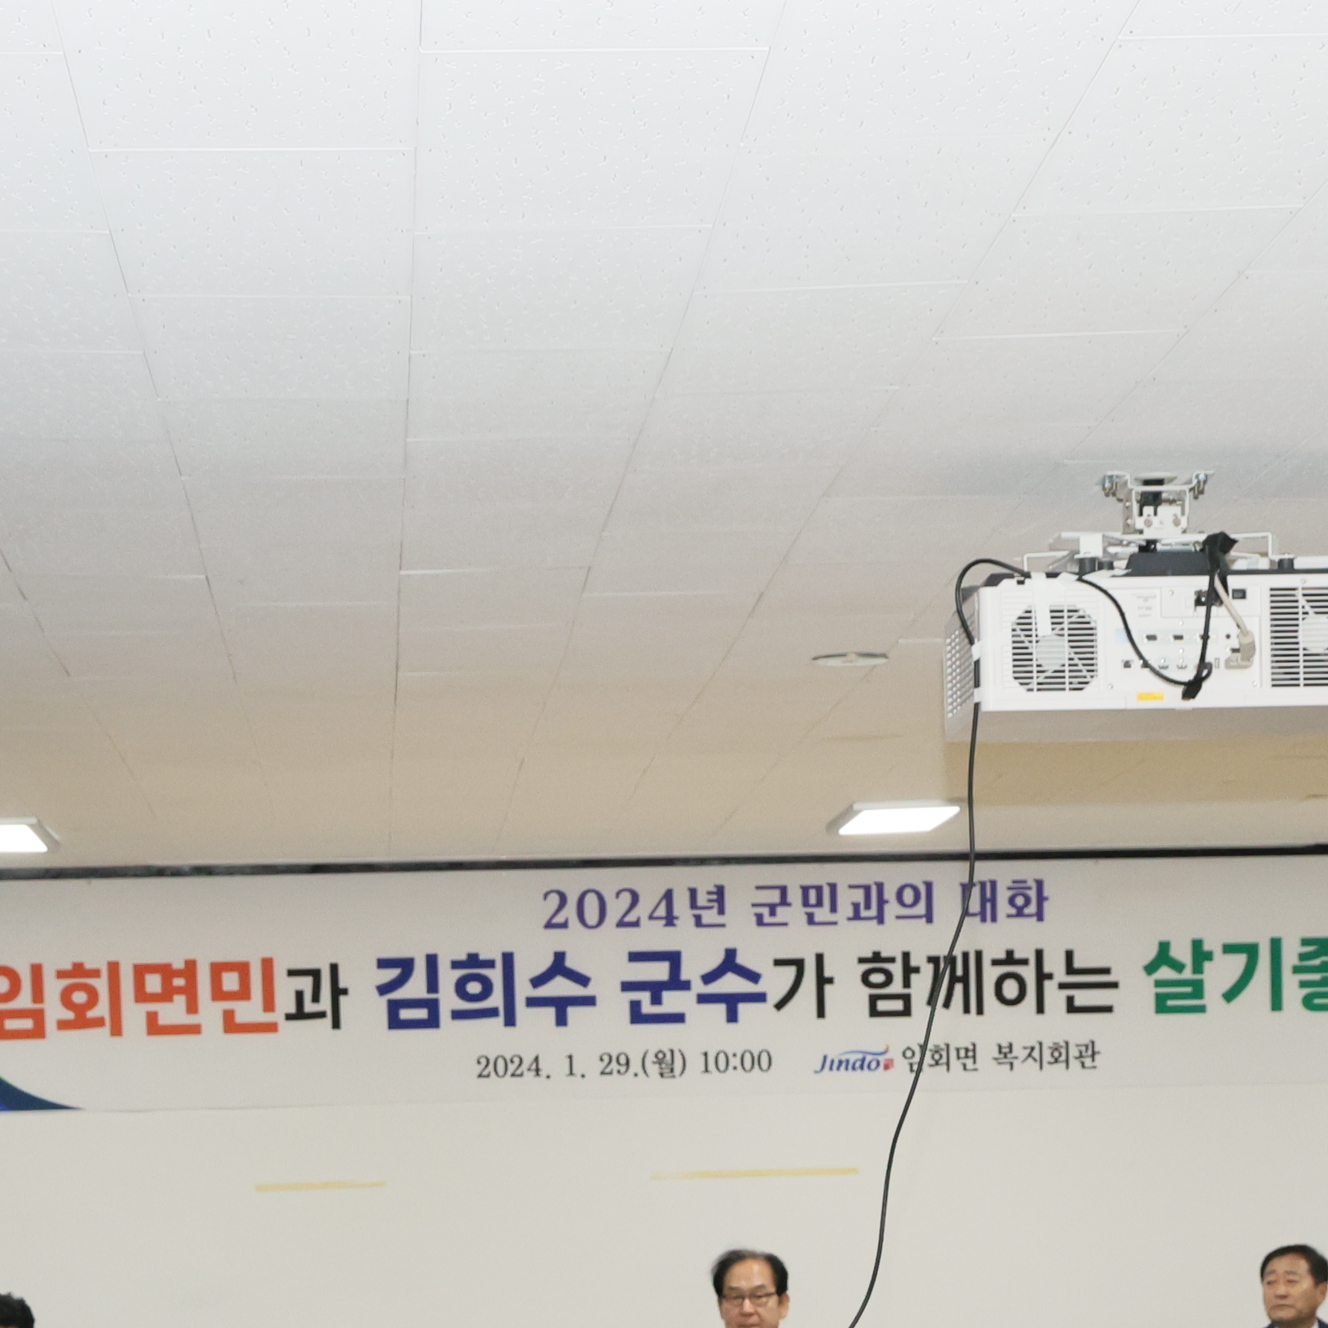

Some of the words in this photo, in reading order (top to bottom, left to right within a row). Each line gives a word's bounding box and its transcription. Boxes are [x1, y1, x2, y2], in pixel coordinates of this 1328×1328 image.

[543, 884, 726, 929] 2024년
[751, 881, 933, 927] 군민과의
[960, 878, 1049, 923] 대화
[375, 951, 597, 1030] 김희수
[620, 947, 834, 1025] 군수가
[857, 947, 1119, 1018] 함께하는
[476, 1054, 552, 1079] 2024.
[565, 1053, 586, 1079] 1.
[599, 1049, 687, 1079] 29.(월)
[701, 1049, 773, 1074] 10:00
[814, 1050, 882, 1074] Jindo
[902, 1041, 979, 1074] 임회면
[992, 1039, 1101, 1071] 복지회관
